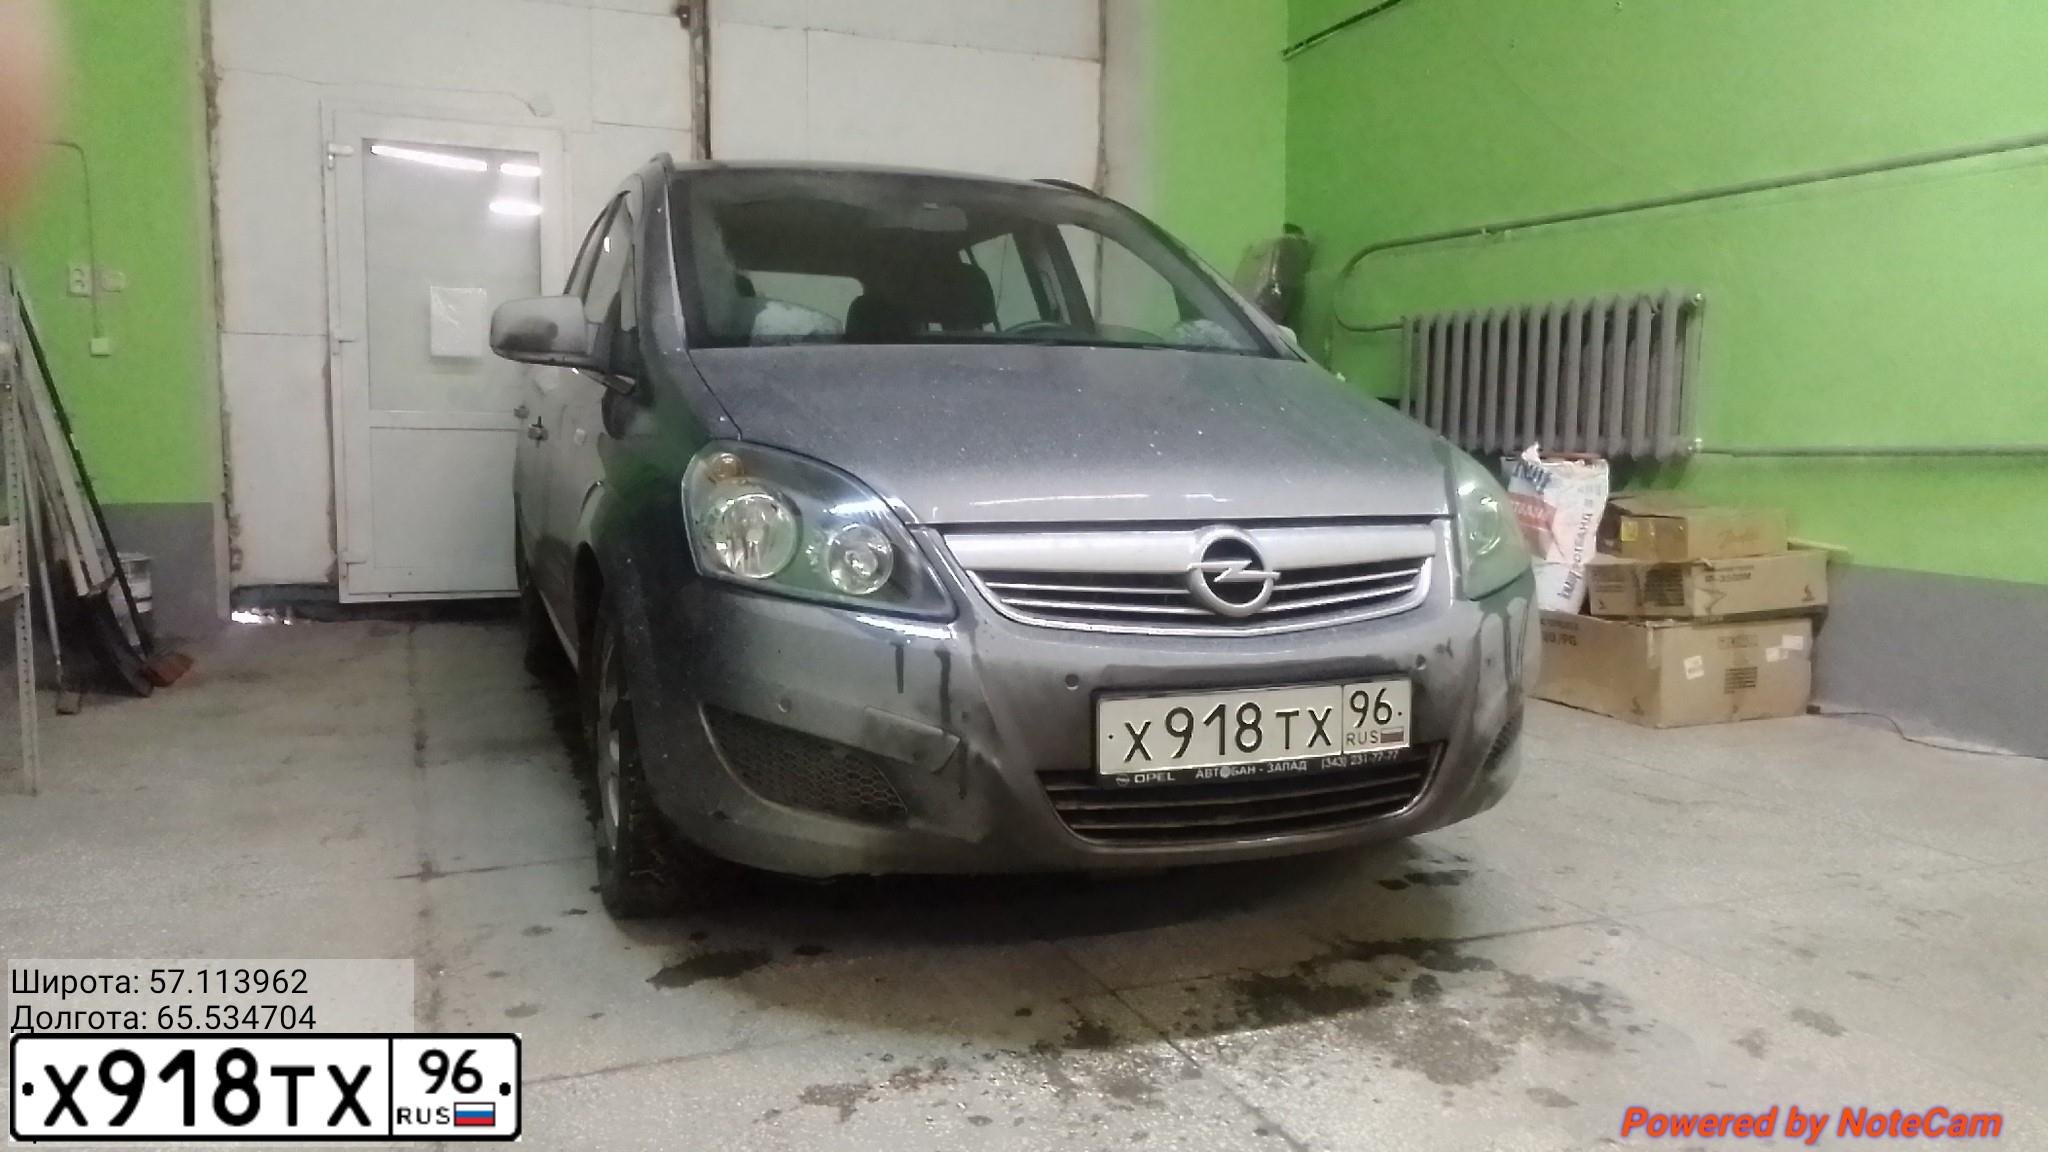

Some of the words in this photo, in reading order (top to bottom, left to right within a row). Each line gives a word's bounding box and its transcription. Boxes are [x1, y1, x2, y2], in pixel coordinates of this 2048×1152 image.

[1349, 686, 1394, 729] 96
[1346, 728, 1380, 747] RUS
[1266, 760, 1308, 774] ЗАПАД
[1320, 755, 1347, 770] (343)
[1350, 750, 1400, 767] 231-77-77
[1133, 771, 1176, 784] OPEL
